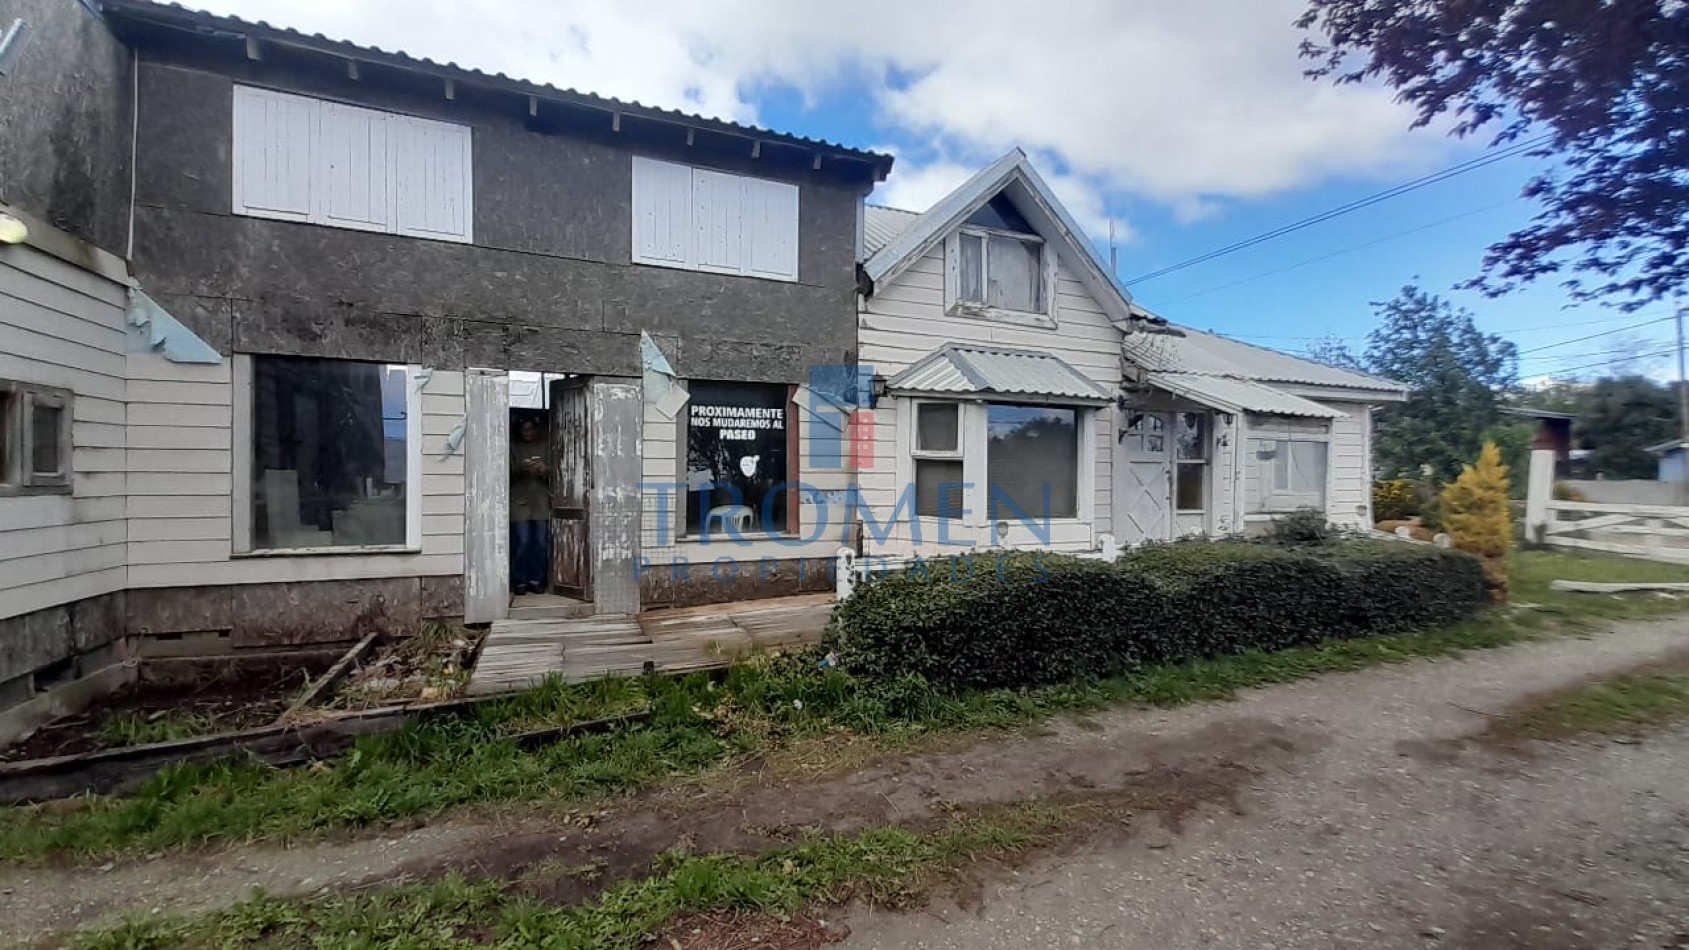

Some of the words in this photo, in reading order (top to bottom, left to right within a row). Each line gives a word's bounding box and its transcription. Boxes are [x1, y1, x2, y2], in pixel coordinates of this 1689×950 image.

[691, 405, 784, 419] PROXIMAMENTE
[691, 417, 710, 427] NOS
[712, 418, 770, 429] MUDAREMOS
[772, 420, 784, 429] AL
[719, 428, 756, 440] PASEO
